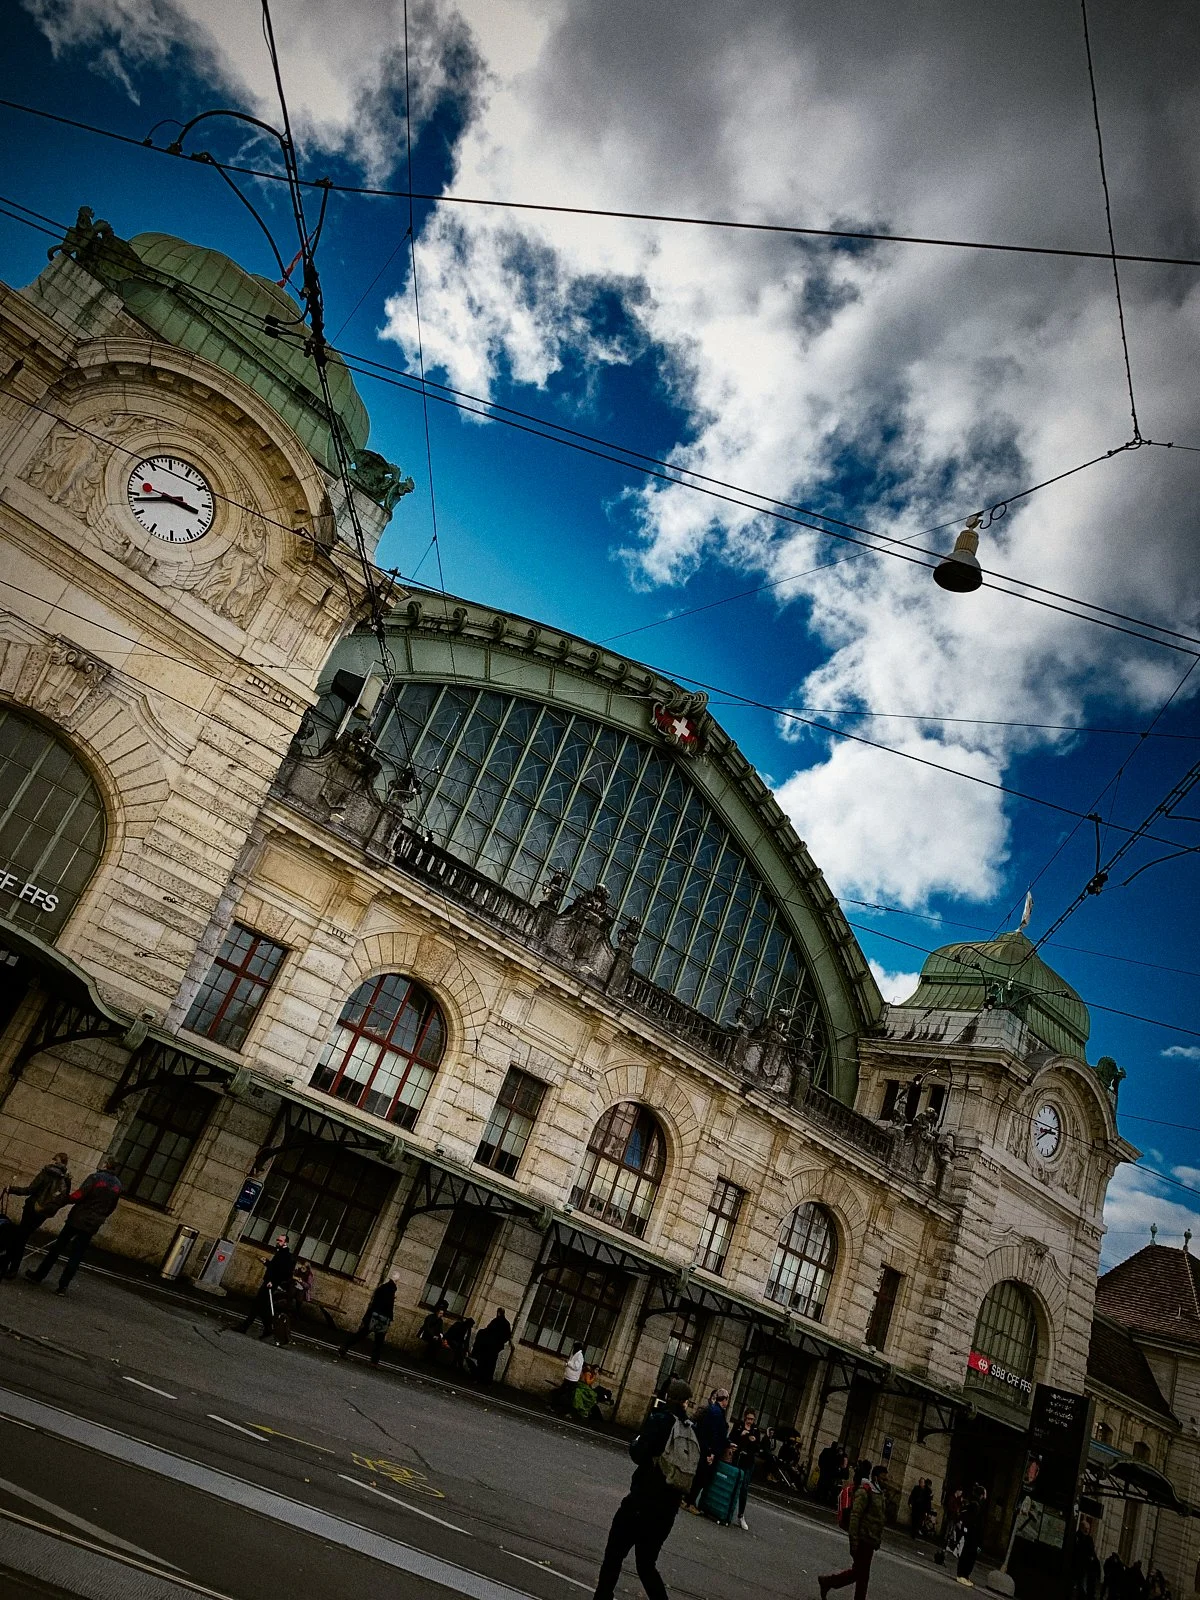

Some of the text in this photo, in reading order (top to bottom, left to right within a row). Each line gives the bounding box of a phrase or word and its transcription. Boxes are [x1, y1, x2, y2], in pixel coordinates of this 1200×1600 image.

[19, 882, 59, 912] FFS
[991, 1364, 1032, 1393] SBB CFF FFS
